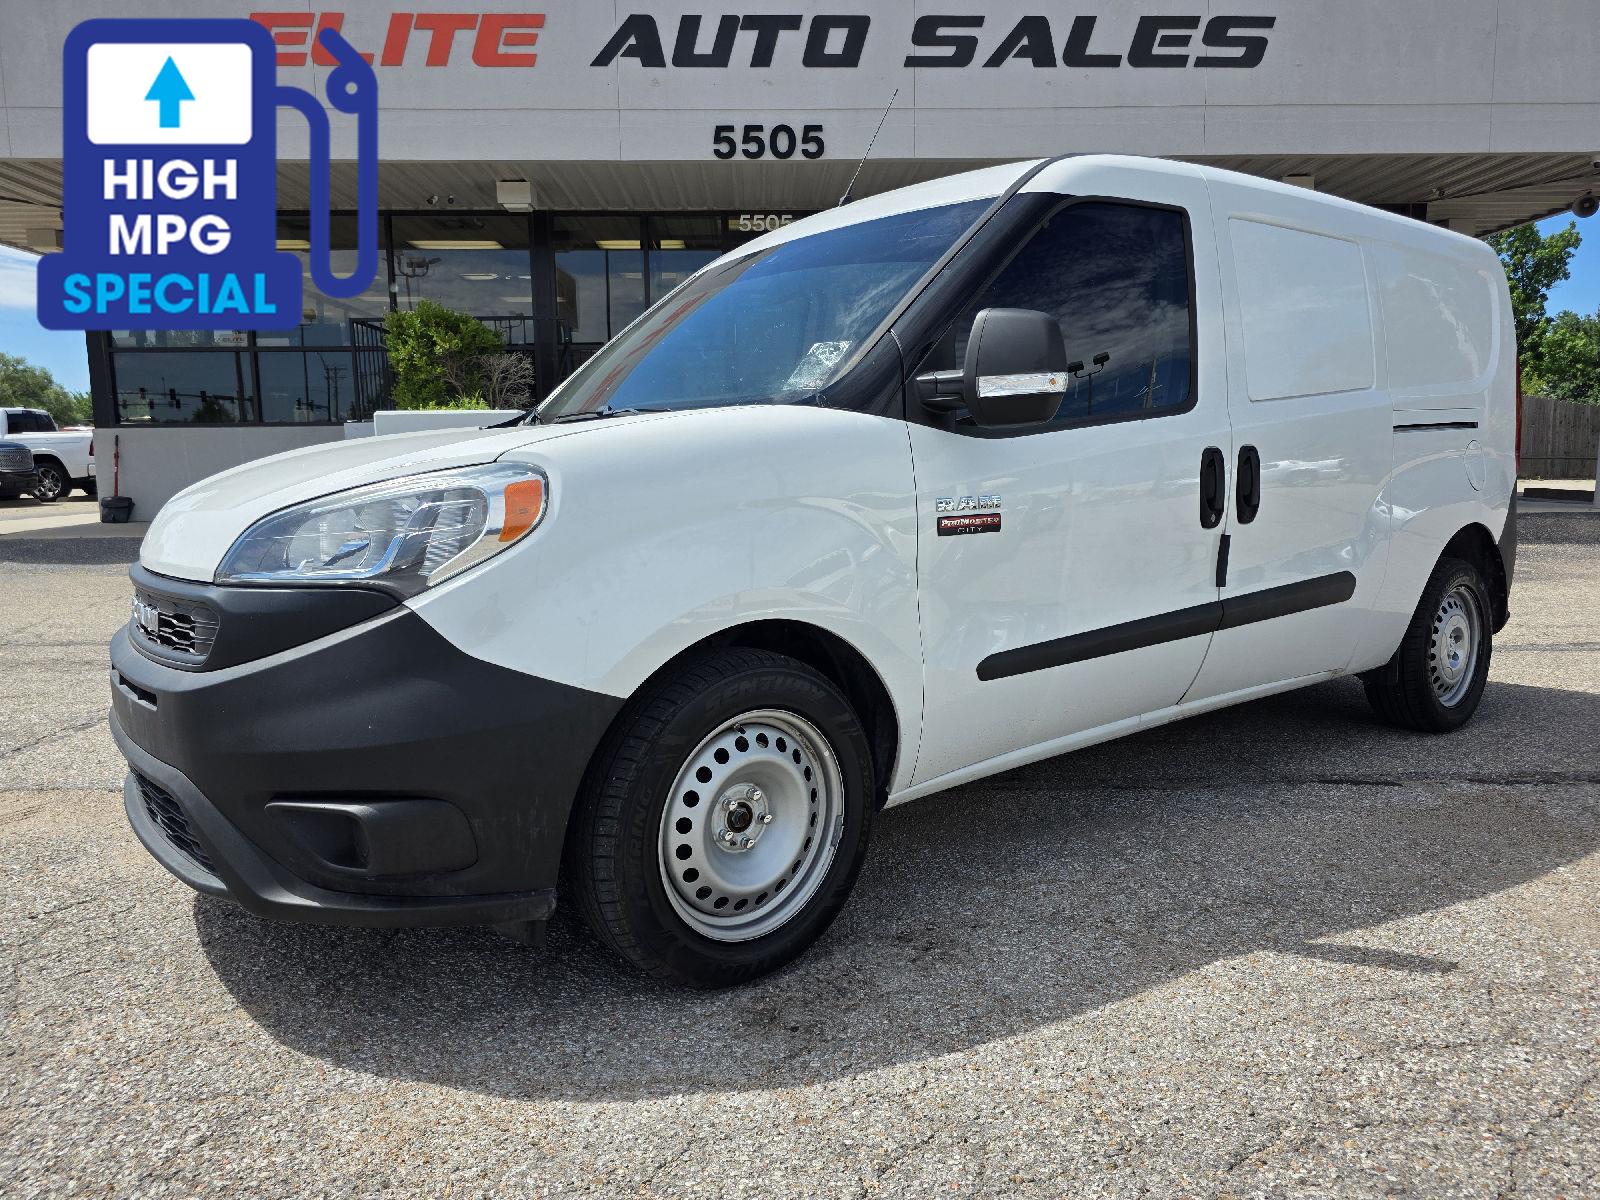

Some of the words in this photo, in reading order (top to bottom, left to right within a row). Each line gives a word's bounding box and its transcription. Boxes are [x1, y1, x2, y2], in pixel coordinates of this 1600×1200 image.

[249, 12, 546, 68] ELITE
[590, 14, 871, 68] AUTO
[904, 15, 1276, 68] SALES
[712, 124, 825, 159] 5505
[936, 495, 1002, 512] RAM
